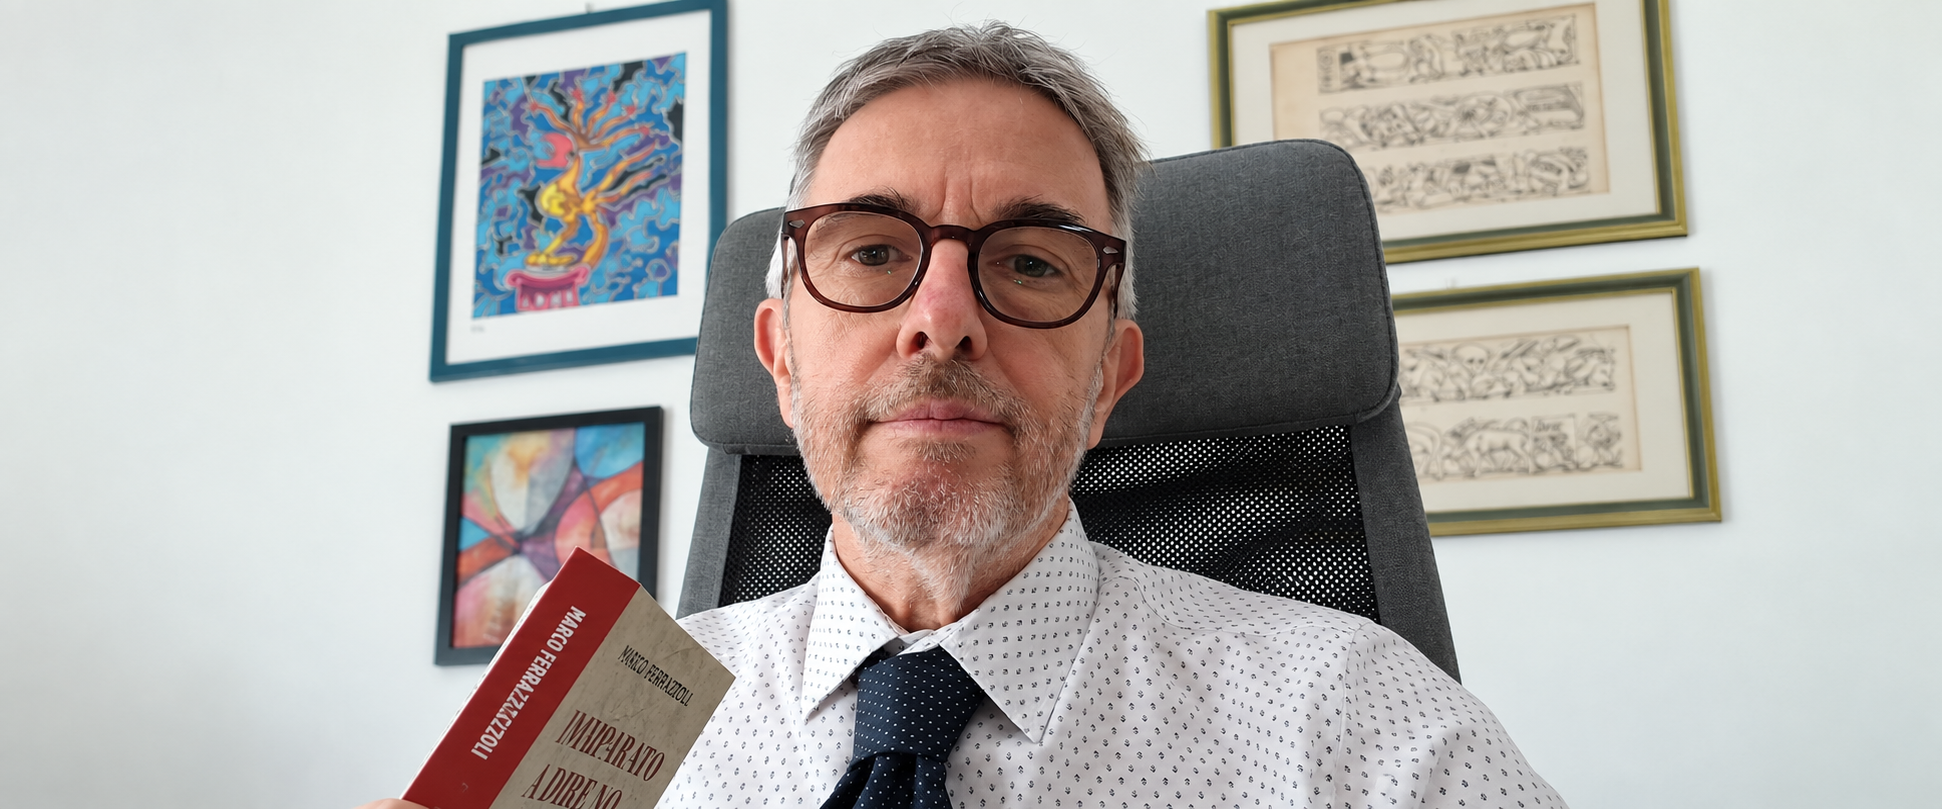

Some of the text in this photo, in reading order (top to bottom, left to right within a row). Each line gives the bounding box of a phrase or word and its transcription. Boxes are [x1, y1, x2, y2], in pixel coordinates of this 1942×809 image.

[546, 605, 587, 652] MARCO
[521, 764, 551, 800] A
[537, 767, 598, 809] DIRE
